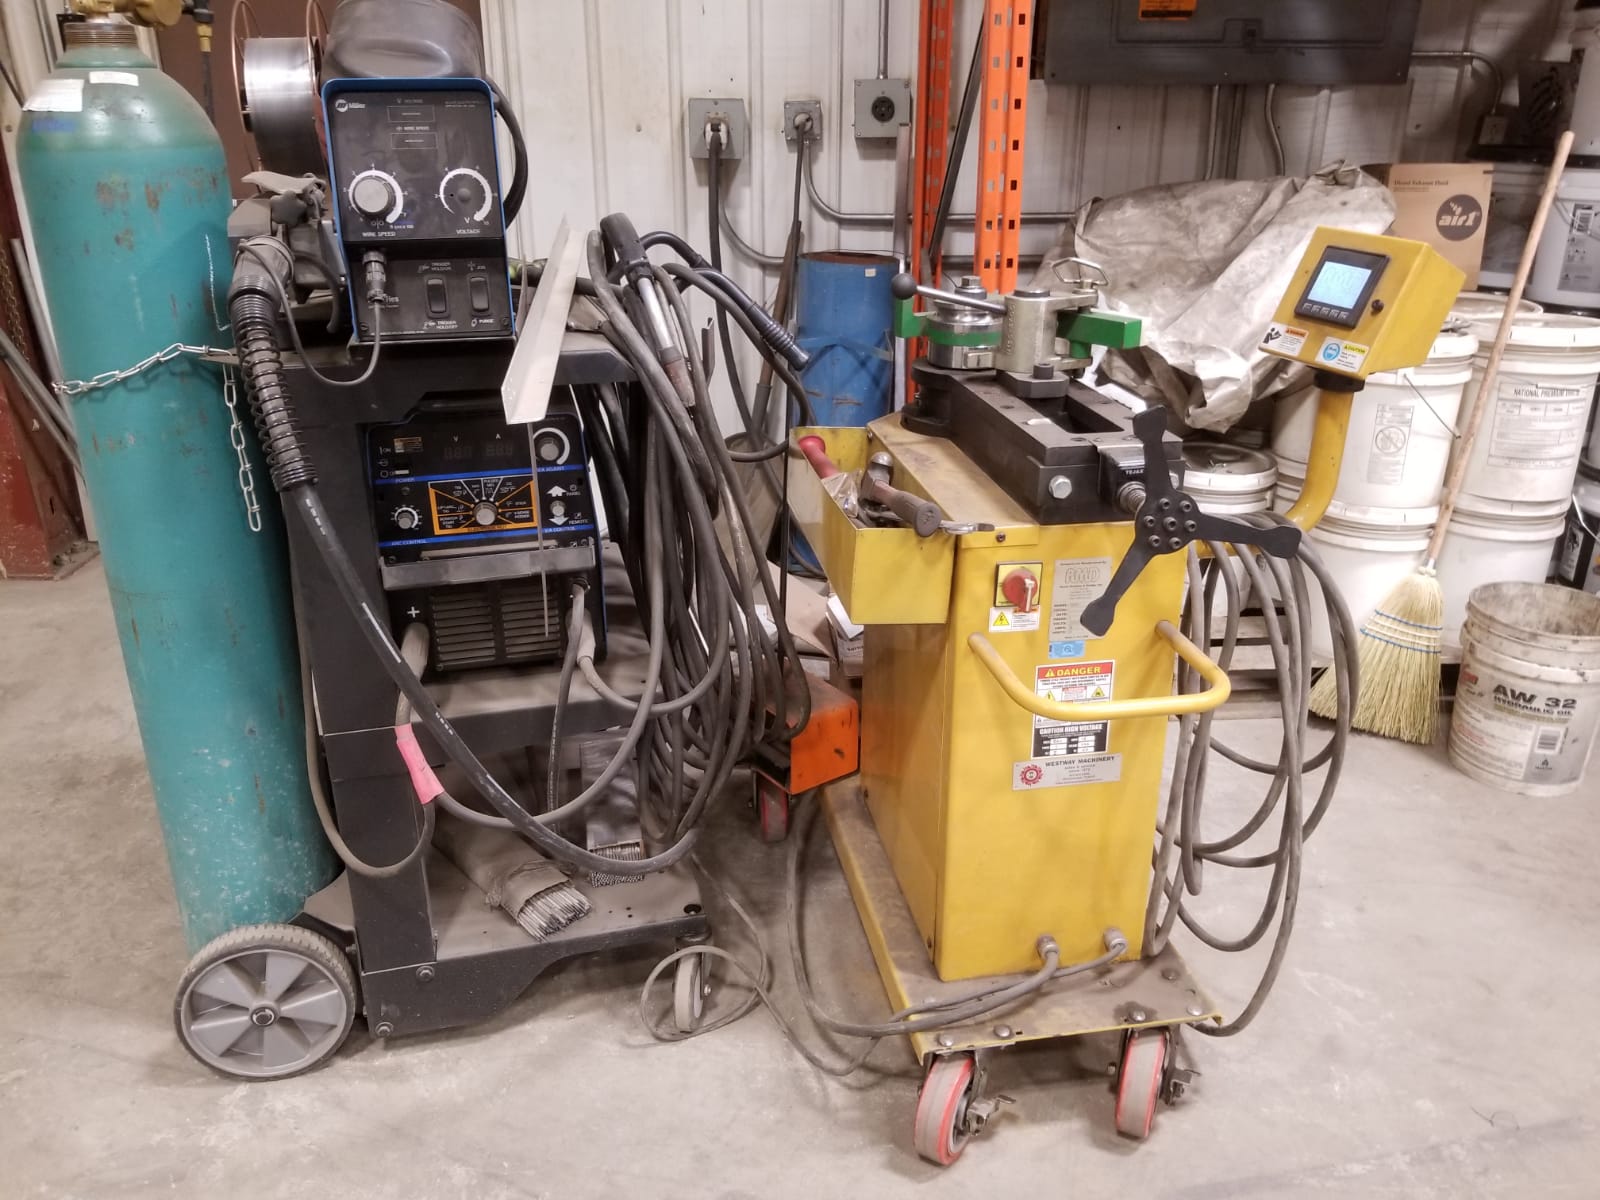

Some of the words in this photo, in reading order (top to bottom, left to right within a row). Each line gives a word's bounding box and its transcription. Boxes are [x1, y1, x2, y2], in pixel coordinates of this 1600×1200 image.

[1514, 387, 1539, 398] NATIONAL
[1057, 667, 1101, 676] DANGER
[1493, 684, 1537, 704] AW
[1545, 697, 1577, 709] 32
[1494, 696, 1554, 716] HYDRAULIC
[1045, 759, 1075, 767] WESTWAY
[1078, 755, 1115, 763] MACHINERY
